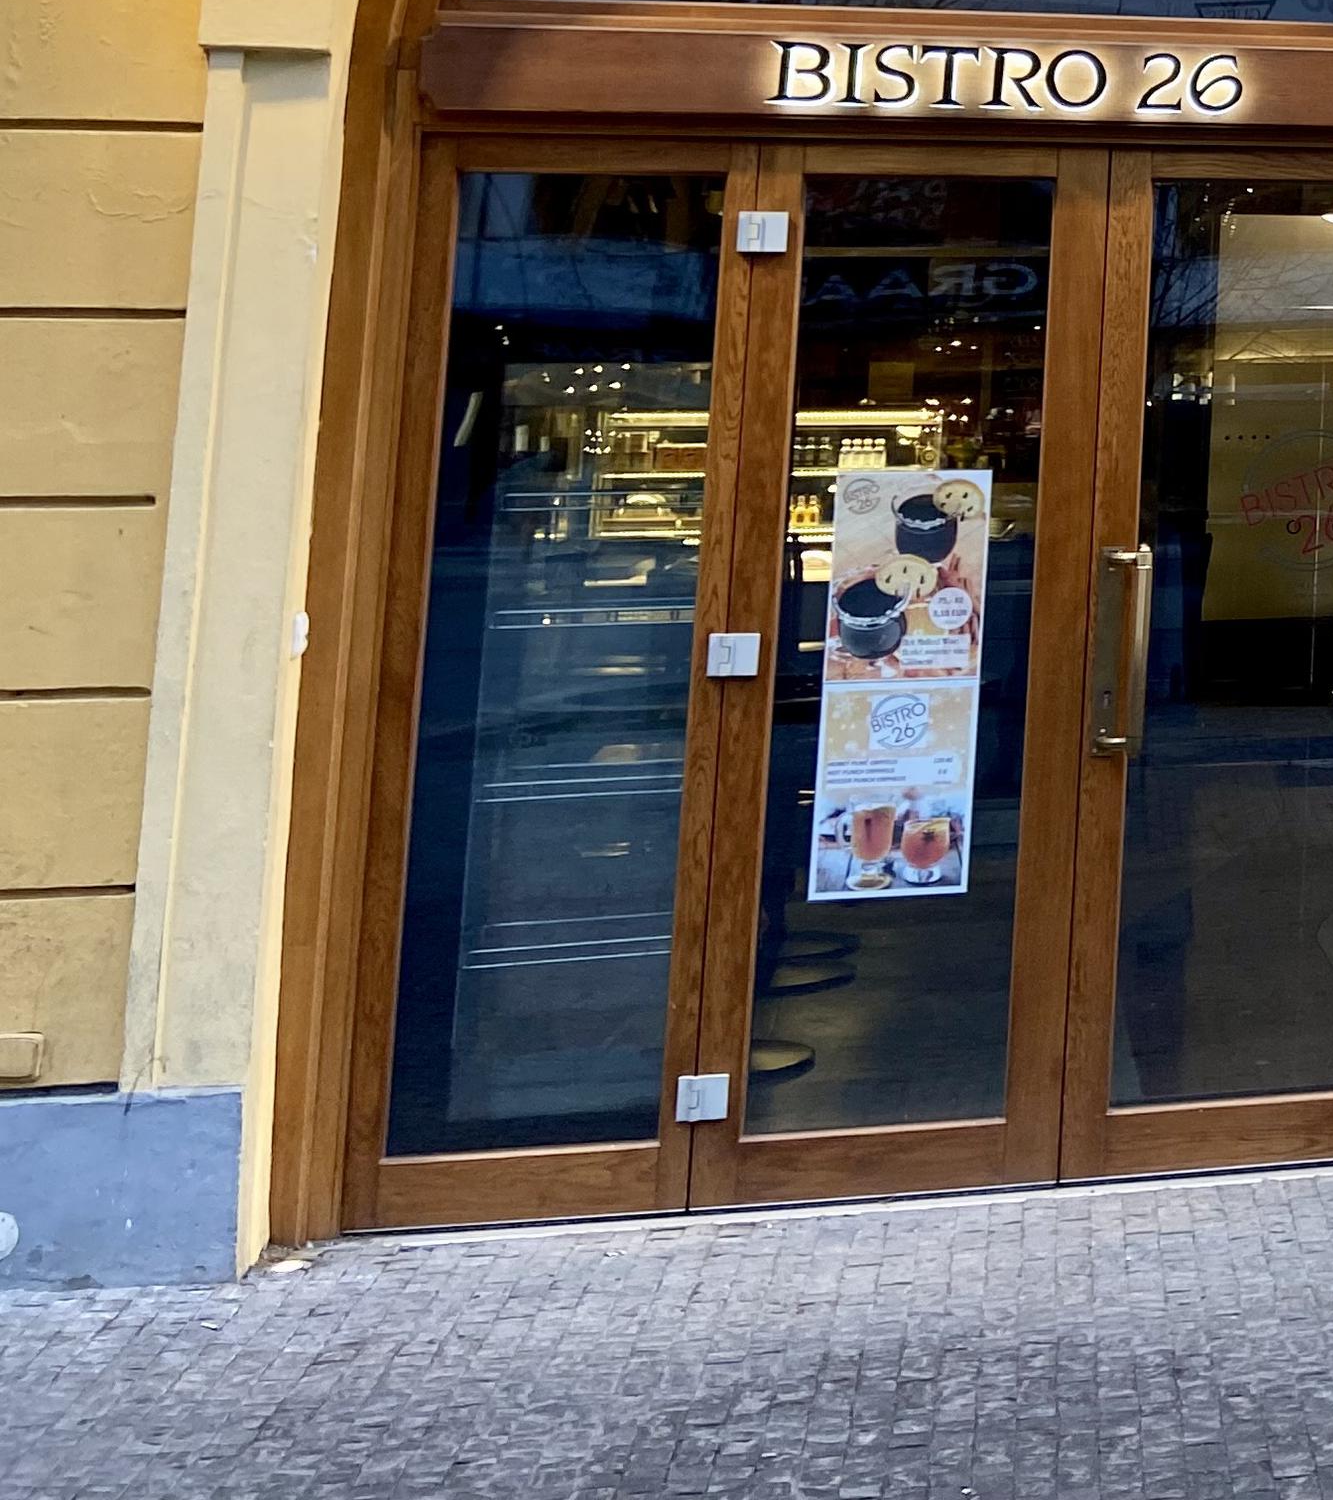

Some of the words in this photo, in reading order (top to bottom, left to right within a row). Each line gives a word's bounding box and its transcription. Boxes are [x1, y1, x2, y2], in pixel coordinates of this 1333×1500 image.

[768, 40, 1108, 112] BISTRO
[1135, 52, 1245, 115] 26
[871, 702, 927, 733] BISTRO
[891, 722, 916, 743] 26
